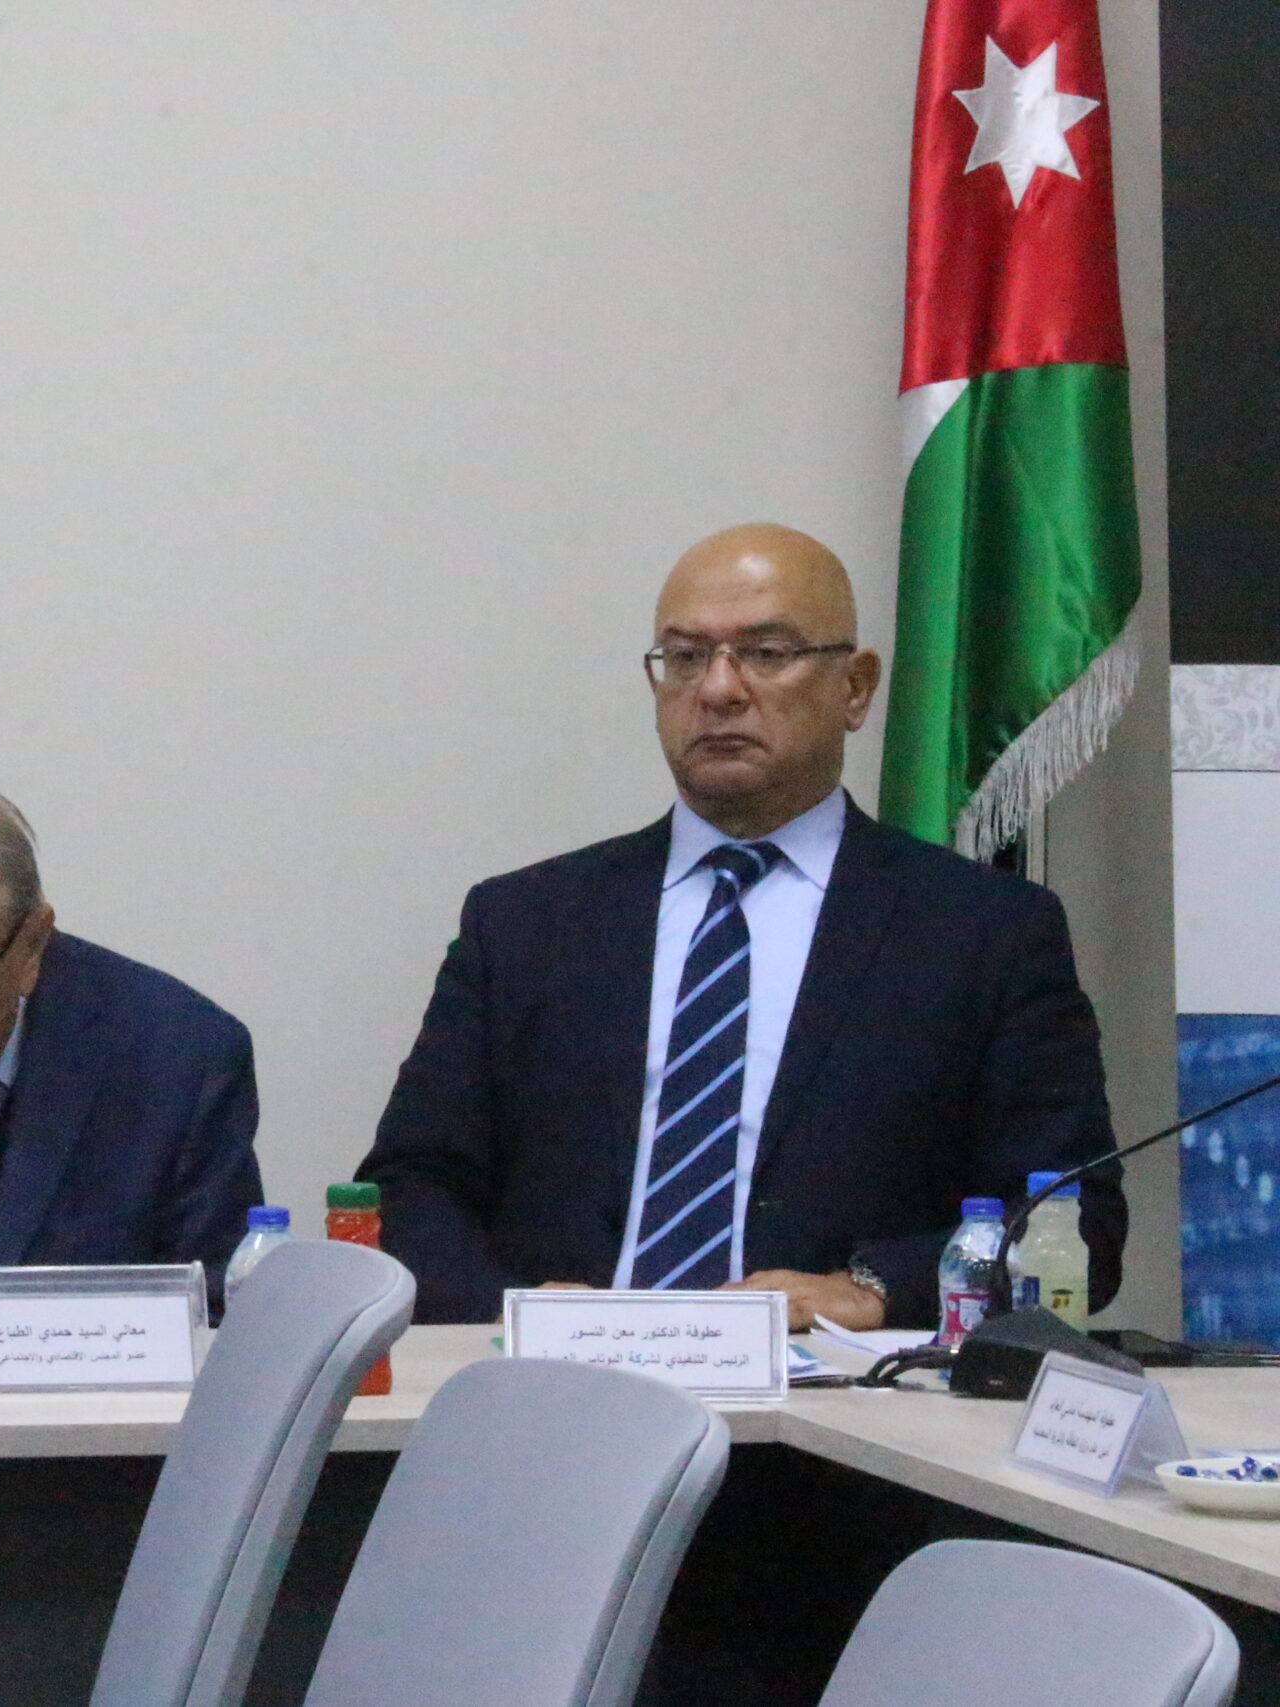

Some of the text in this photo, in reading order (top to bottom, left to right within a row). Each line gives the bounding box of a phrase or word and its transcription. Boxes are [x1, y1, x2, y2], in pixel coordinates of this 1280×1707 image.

[38, 1327, 72, 1343] حمدي
[79, 1324, 107, 1339] السيد
[113, 1324, 146, 1342] معالي
[569, 1324, 723, 1341] عطوفة الدكتور معن النسور
[628, 1351, 661, 1365] لشركة
[712, 1352, 750, 1367] الرئيس
